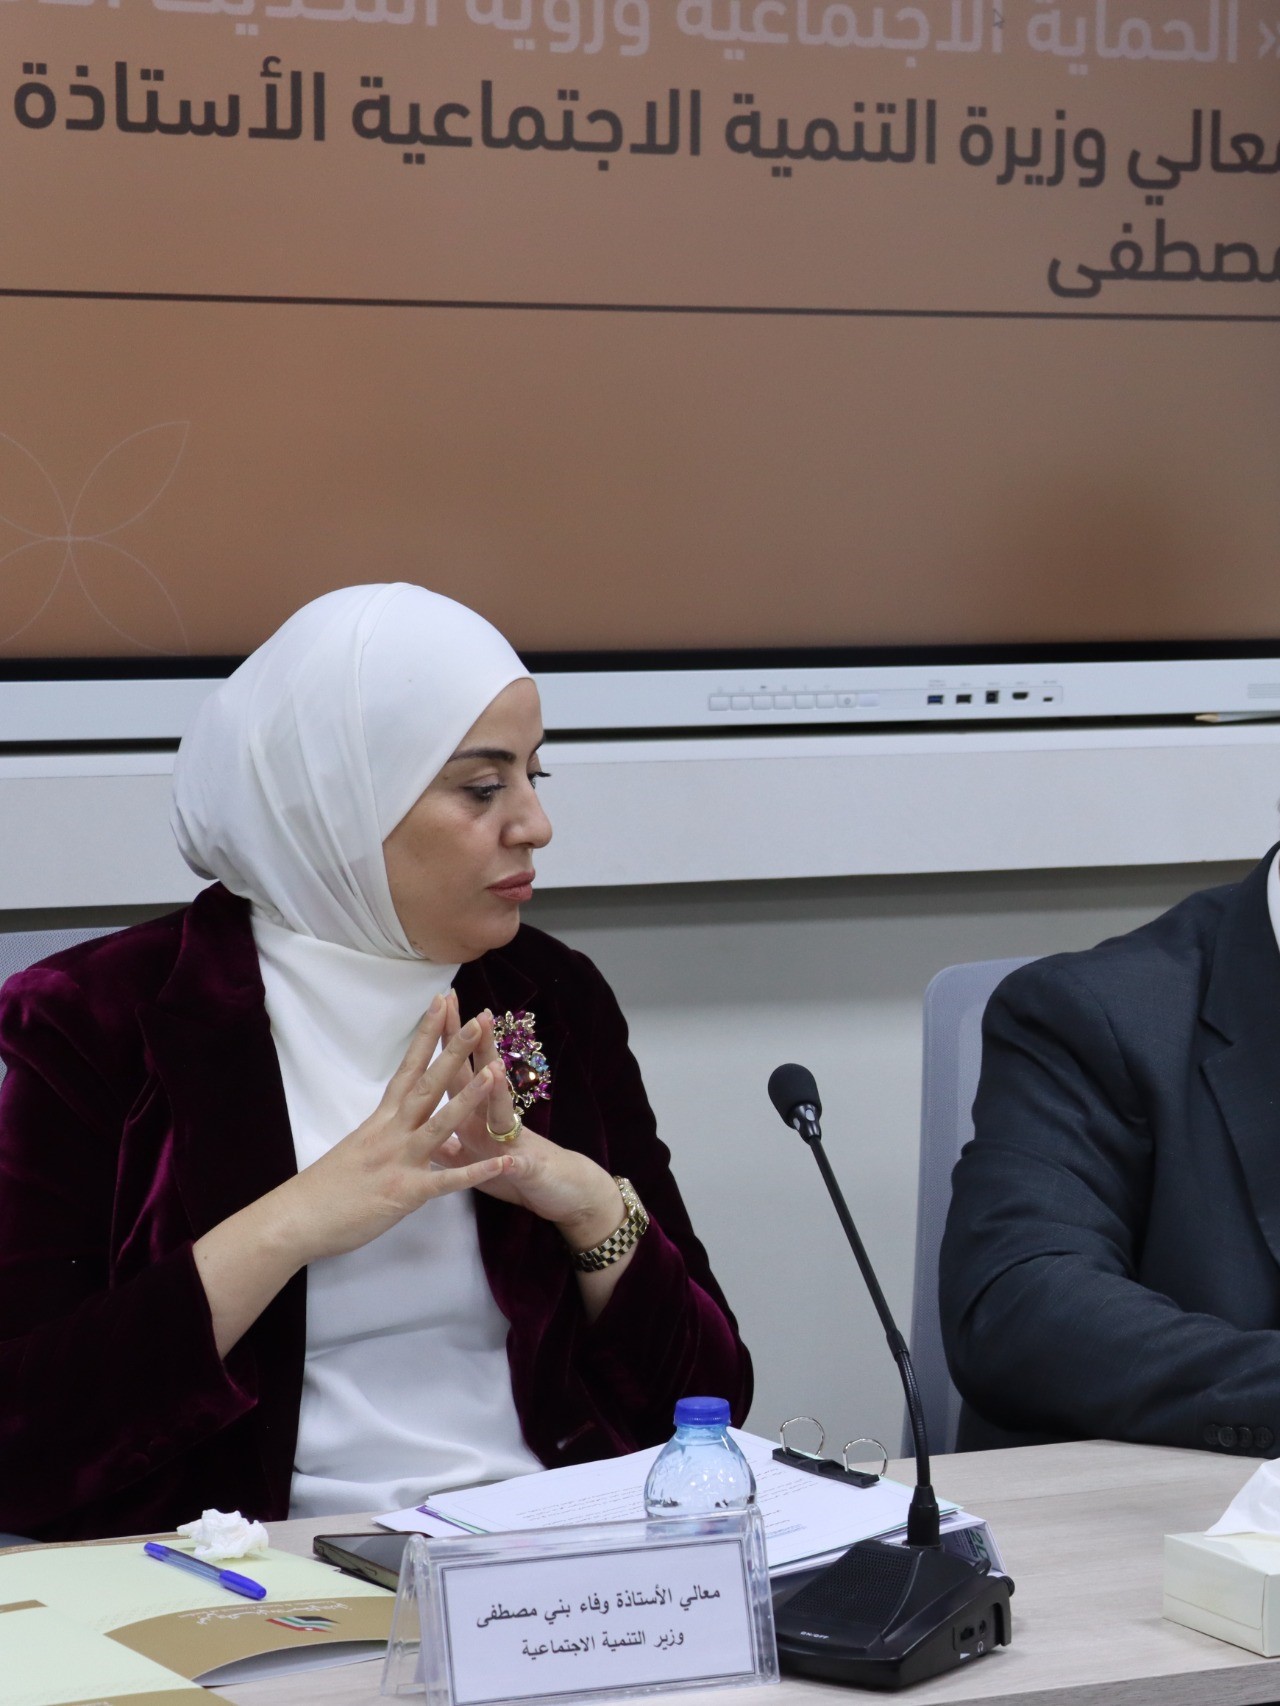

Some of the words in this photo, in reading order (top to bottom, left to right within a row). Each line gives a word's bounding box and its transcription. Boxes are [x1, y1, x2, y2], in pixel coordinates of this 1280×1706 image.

[1027, 0, 1238, 75] الحماية
[13, 55, 325, 142] الأستاذة
[351, 76, 701, 171] الاجتماعية
[724, 92, 936, 177] التنمية
[959, 106, 1106, 188] وزيرة
[579, 1592, 610, 1615] وفاء
[616, 1583, 673, 1609] الأستاذة
[679, 1584, 721, 1612] معالي
[476, 1603, 538, 1629] مصطفى
[544, 1598, 571, 1625] بني
[521, 1635, 595, 1660] الاجتماعية
[601, 1630, 646, 1652] التنمية
[653, 1628, 685, 1648] وزير
